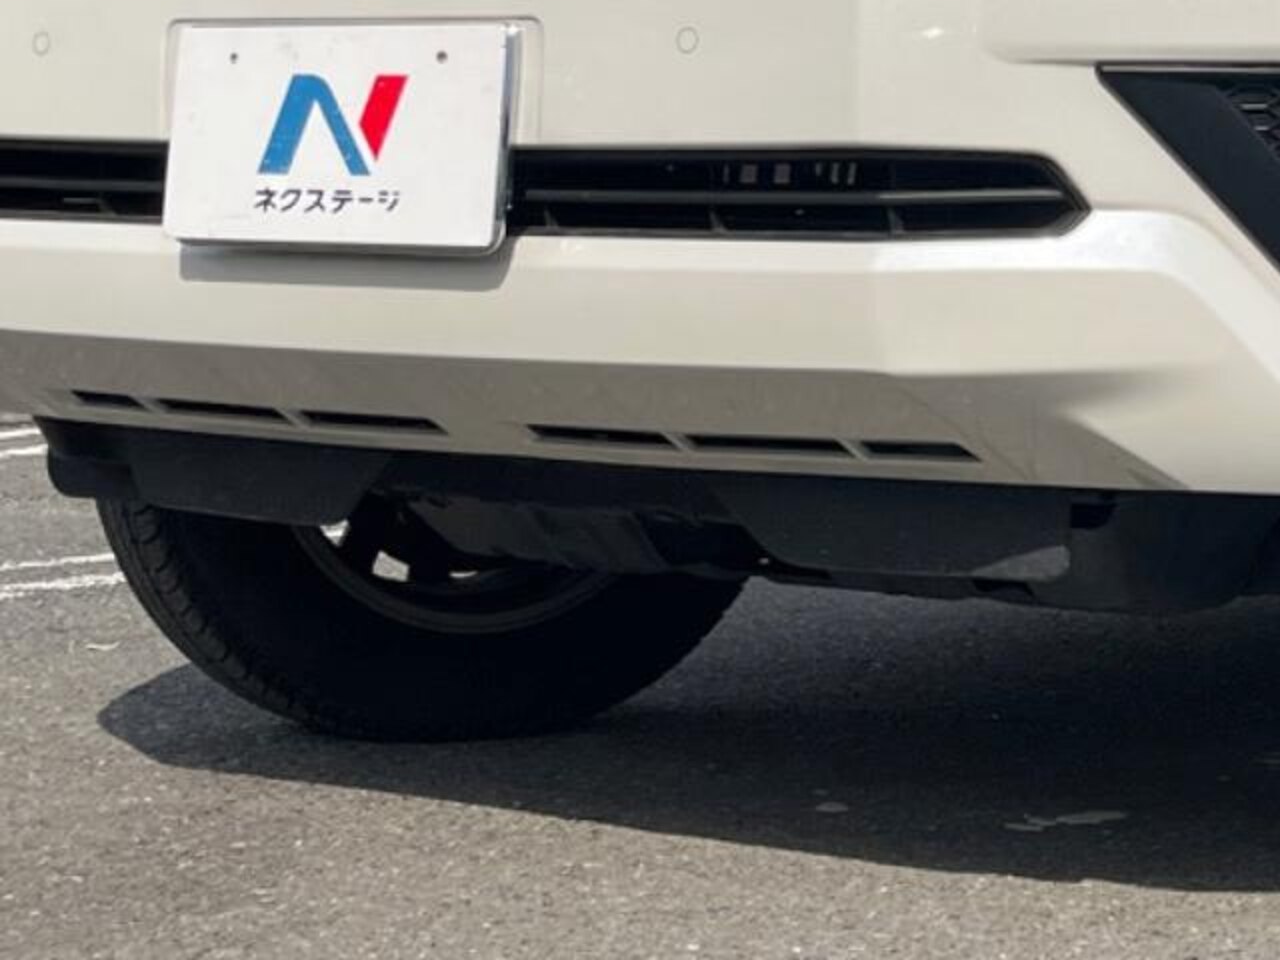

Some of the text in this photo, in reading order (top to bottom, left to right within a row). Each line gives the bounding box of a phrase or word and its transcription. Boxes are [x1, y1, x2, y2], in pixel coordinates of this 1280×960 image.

[253, 187, 400, 214] ネクステージ
